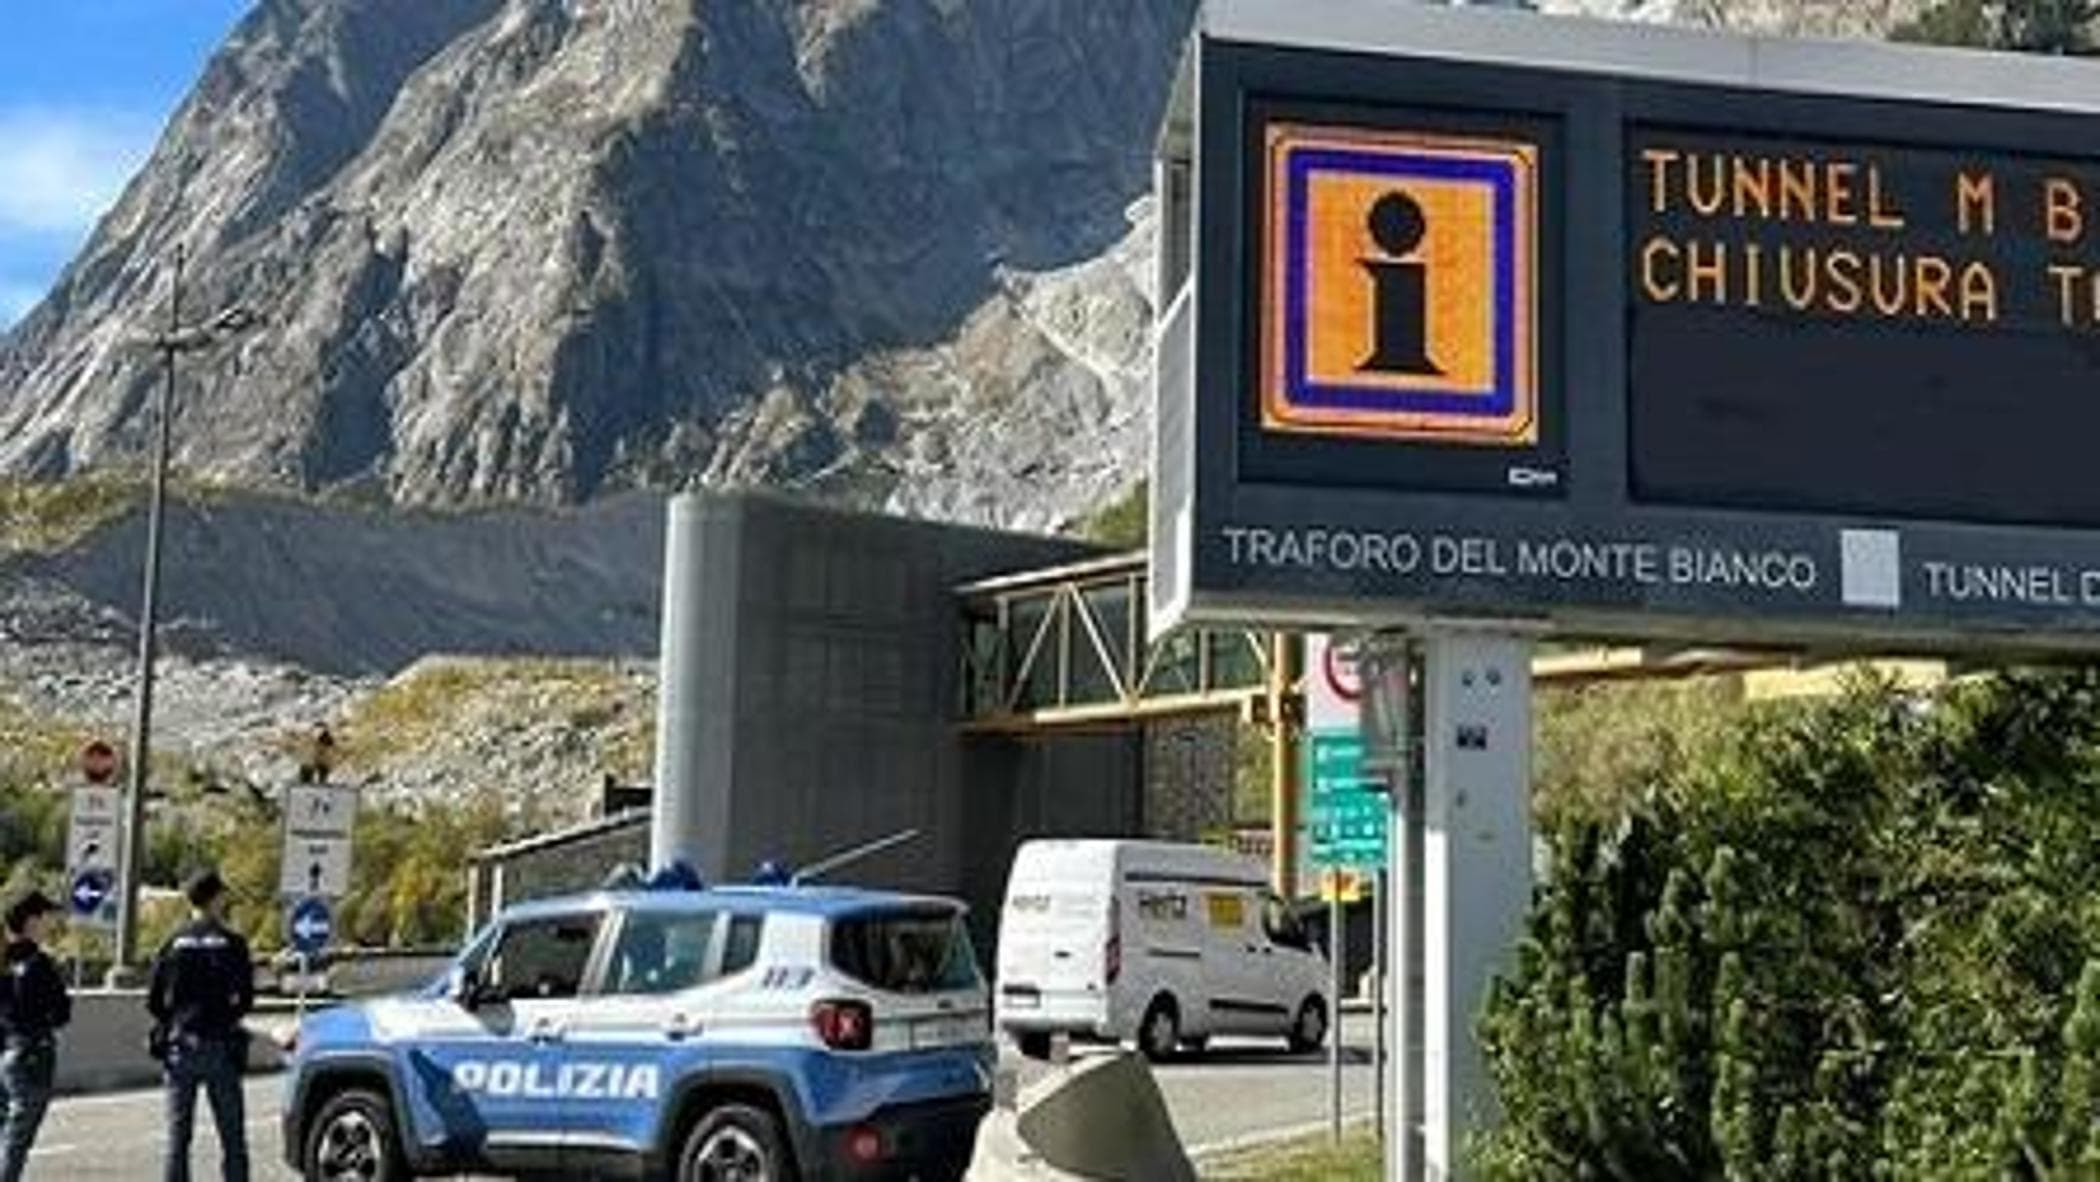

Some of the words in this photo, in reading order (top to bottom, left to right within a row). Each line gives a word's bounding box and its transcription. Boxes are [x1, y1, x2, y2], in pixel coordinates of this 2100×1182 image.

[1642, 149, 1905, 228] TUNNEL
[1957, 172, 1995, 235] M
[2046, 179, 2083, 243] B
[1643, 237, 1996, 321] CHIUSURA
[2048, 266, 2100, 325] T
[1222, 527, 1421, 574] TRAFORO
[1432, 536, 1507, 575] DEL
[1517, 539, 1659, 583] MONTE
[1669, 546, 1817, 588] BIANCO
[1923, 562, 2071, 602] TUNNEL
[453, 1060, 659, 1099] POLIZIA
